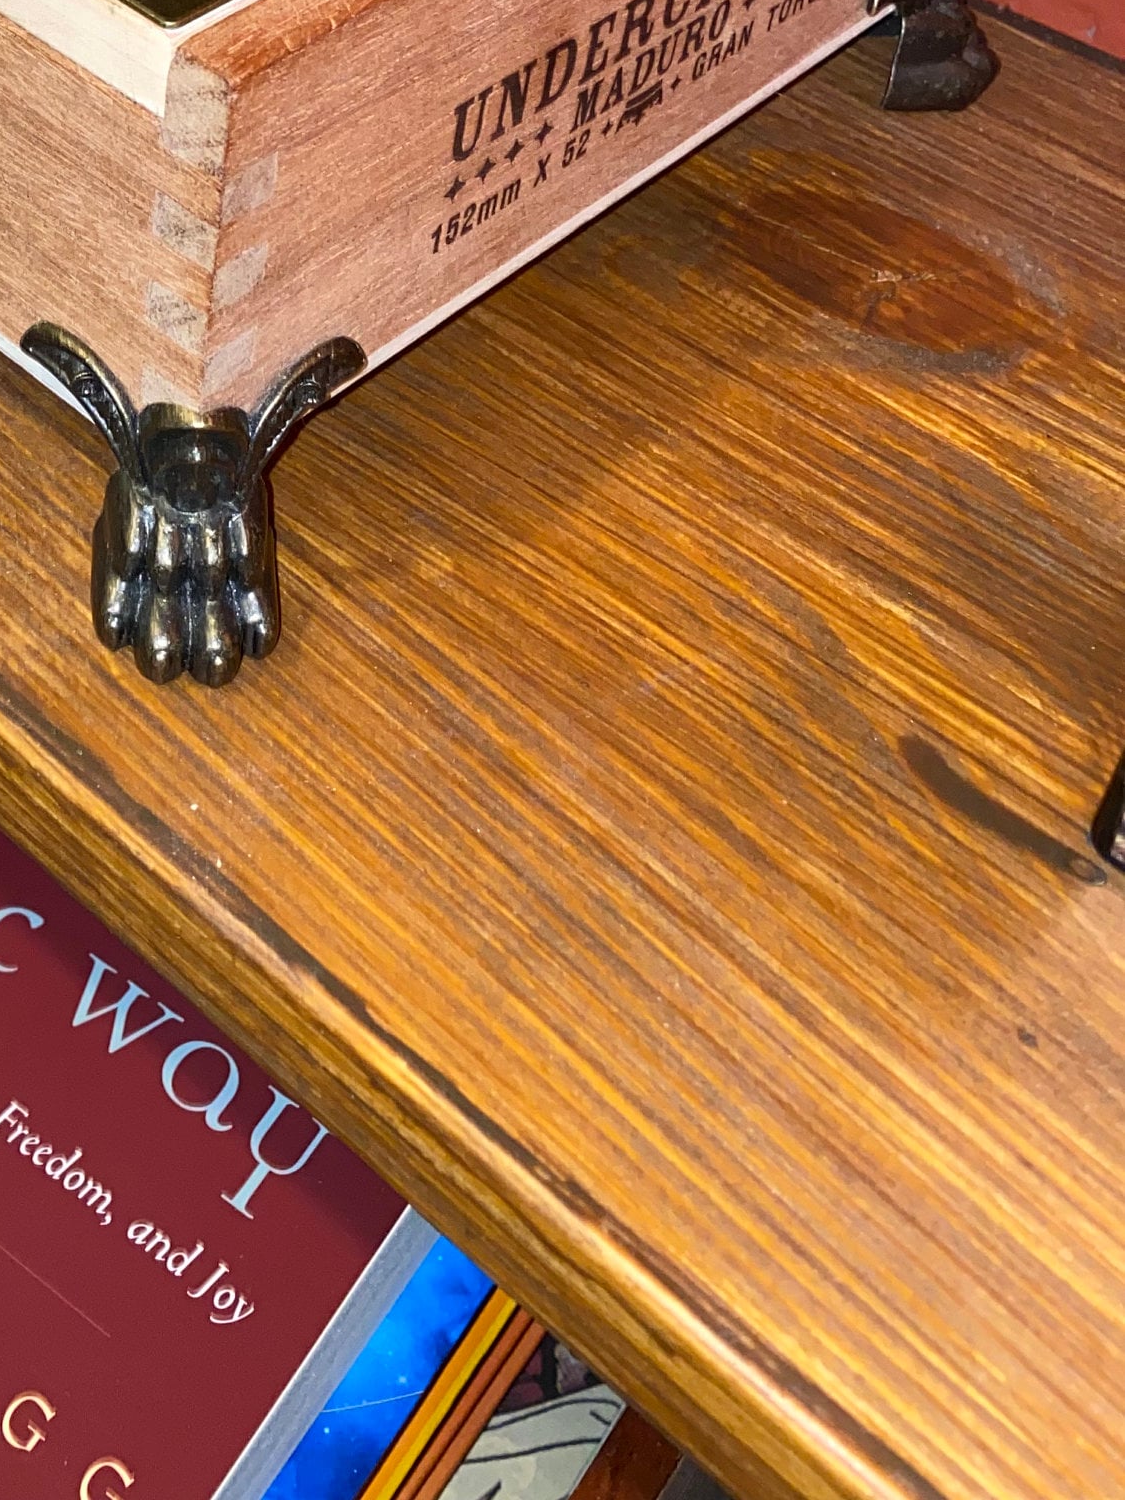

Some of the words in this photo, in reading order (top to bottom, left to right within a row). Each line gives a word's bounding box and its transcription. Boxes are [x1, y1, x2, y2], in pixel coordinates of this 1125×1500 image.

[431, 177, 522, 255] 152mm
[561, 128, 591, 169] 52
[691, 19, 755, 82] GRAN
[72, 953, 331, 1221] way
[126, 1220, 205, 1278] and
[186, 1260, 256, 1325] Joy
